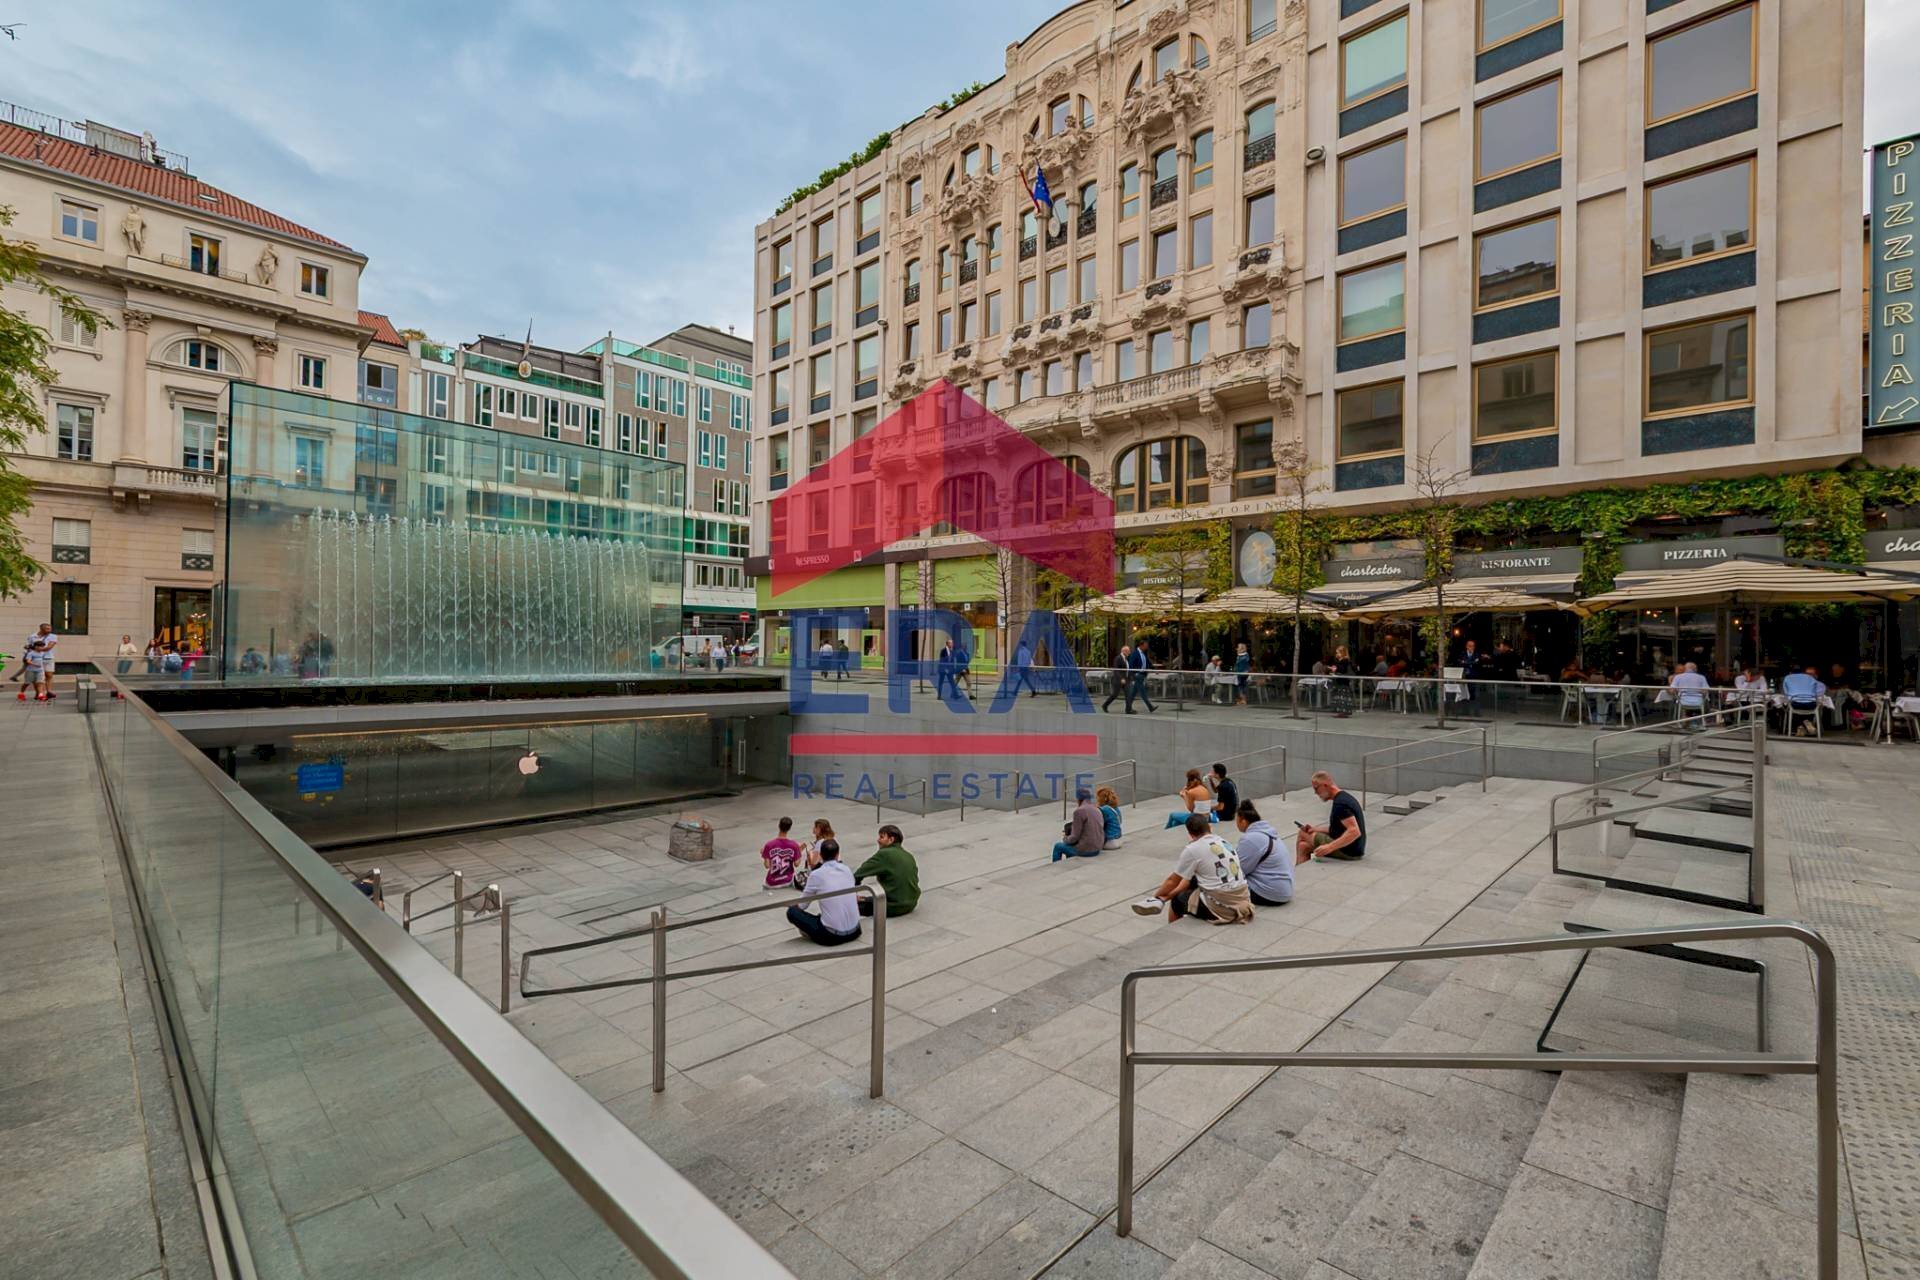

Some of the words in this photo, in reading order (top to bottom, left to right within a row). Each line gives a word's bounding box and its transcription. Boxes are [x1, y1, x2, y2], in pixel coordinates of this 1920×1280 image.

[1881, 140, 1915, 388] PIZZERIA
[1663, 548, 1728, 560] PIZZERIA
[1481, 557, 1552, 569] RISTORANTE
[1340, 563, 1402, 577] charleston
